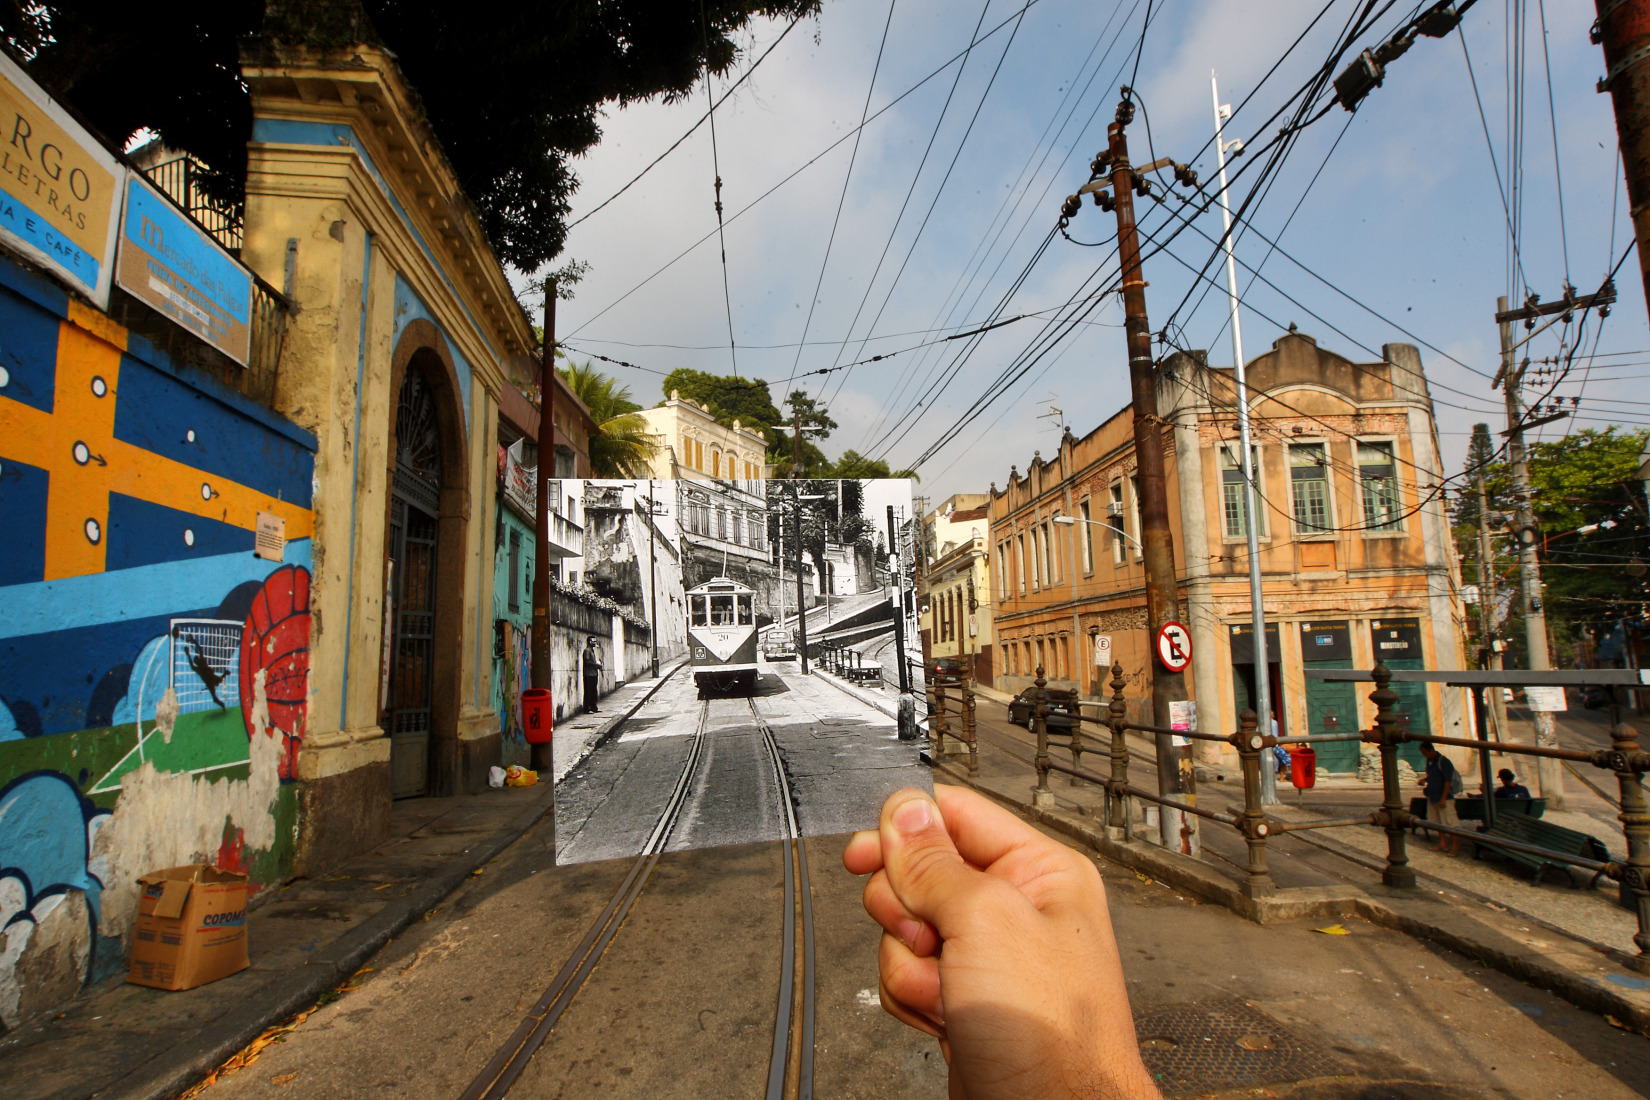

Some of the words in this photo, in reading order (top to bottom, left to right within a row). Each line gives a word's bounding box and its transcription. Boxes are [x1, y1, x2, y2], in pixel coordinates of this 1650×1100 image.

[0, 112, 91, 202] RGO
[2, 152, 87, 230] LETRAS
[26, 217, 37, 234] E
[45, 232, 82, 267] CAFÉ
[200, 267, 215, 293] das
[1101, 640, 1106, 648] E
[1168, 632, 1183, 660] E
